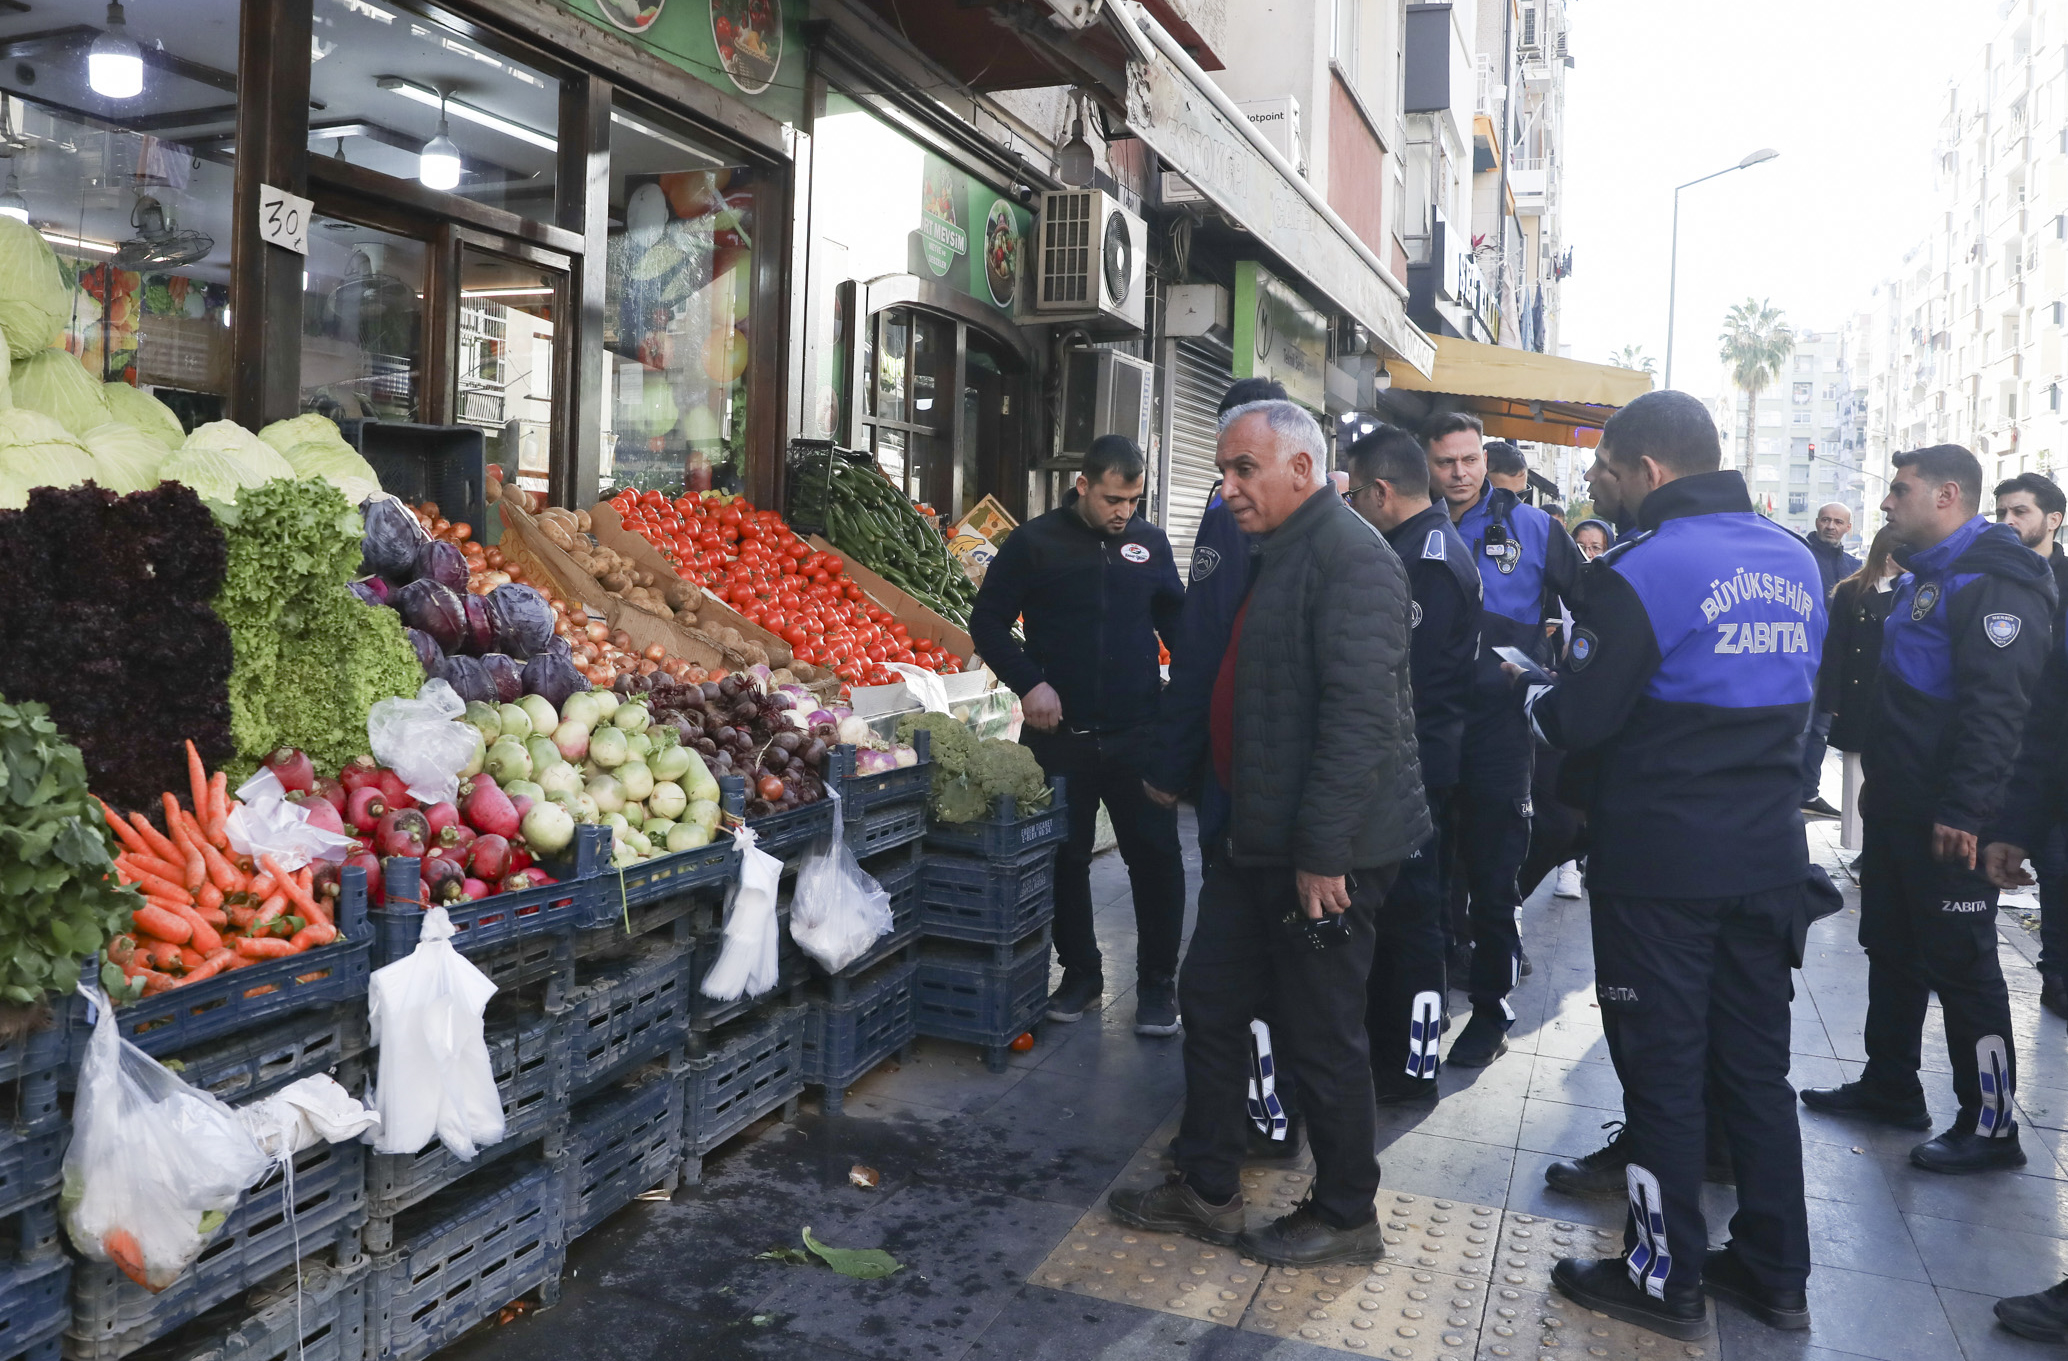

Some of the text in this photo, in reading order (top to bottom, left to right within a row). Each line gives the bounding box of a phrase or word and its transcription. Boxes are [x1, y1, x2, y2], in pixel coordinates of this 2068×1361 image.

[265, 200, 299, 238] 30
[1700, 566, 1814, 625] BÜYÜKŞEHİR
[1714, 621, 1809, 654] ZABITA
[1942, 900, 1987, 913] ZABITA
